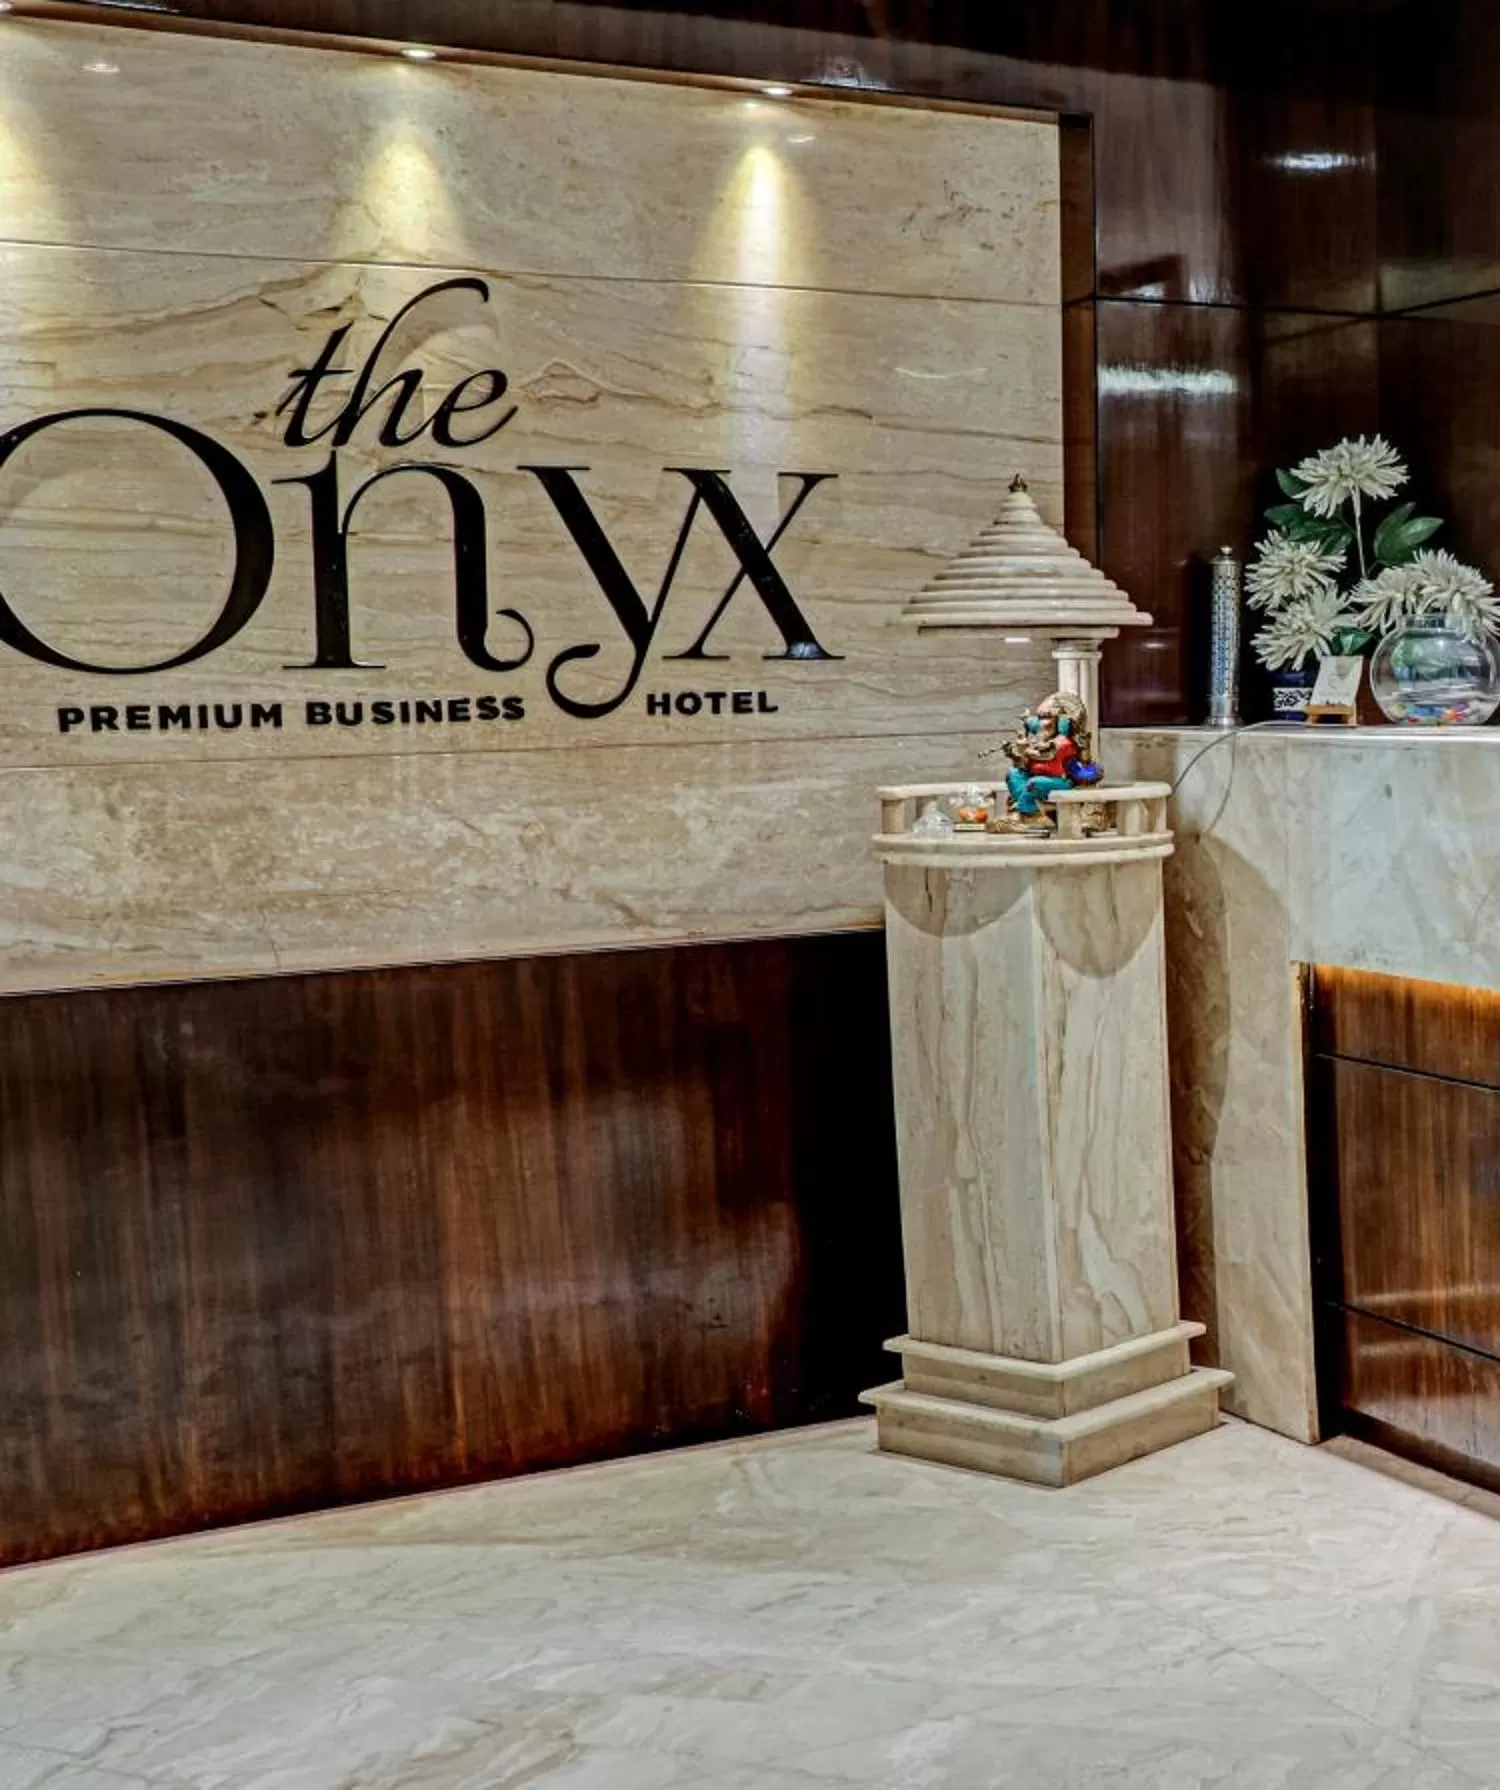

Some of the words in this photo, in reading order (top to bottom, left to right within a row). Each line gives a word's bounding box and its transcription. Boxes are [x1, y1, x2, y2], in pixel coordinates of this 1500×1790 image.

[274, 277, 520, 448] the
[0, 408, 845, 718] Onyx
[57, 702, 284, 733] PREMIUM
[305, 696, 526, 726] BUSINESS
[645, 690, 780, 717] HOTEL
